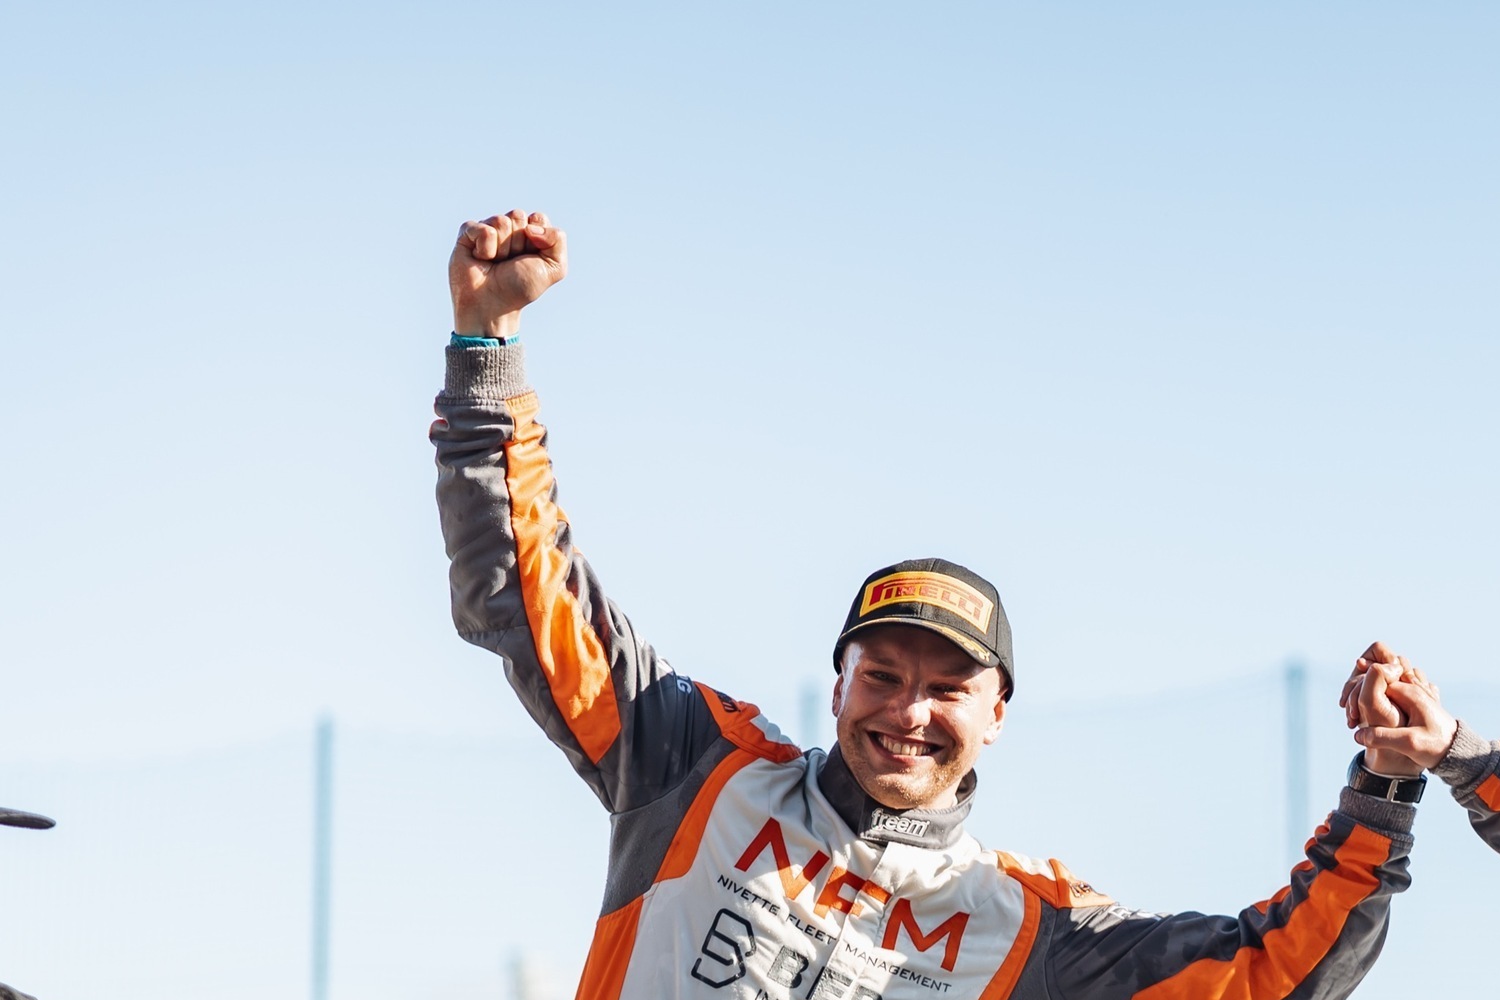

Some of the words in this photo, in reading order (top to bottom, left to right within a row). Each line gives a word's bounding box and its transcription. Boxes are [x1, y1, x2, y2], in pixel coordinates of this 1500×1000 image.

[867, 575, 986, 621] PIRELLI
[871, 807, 930, 838] freem
[716, 872, 781, 917] NIVETTE
[785, 909, 837, 947] FLEET
[845, 941, 953, 995] MANAGEMENT
[735, 817, 971, 973] NFM
